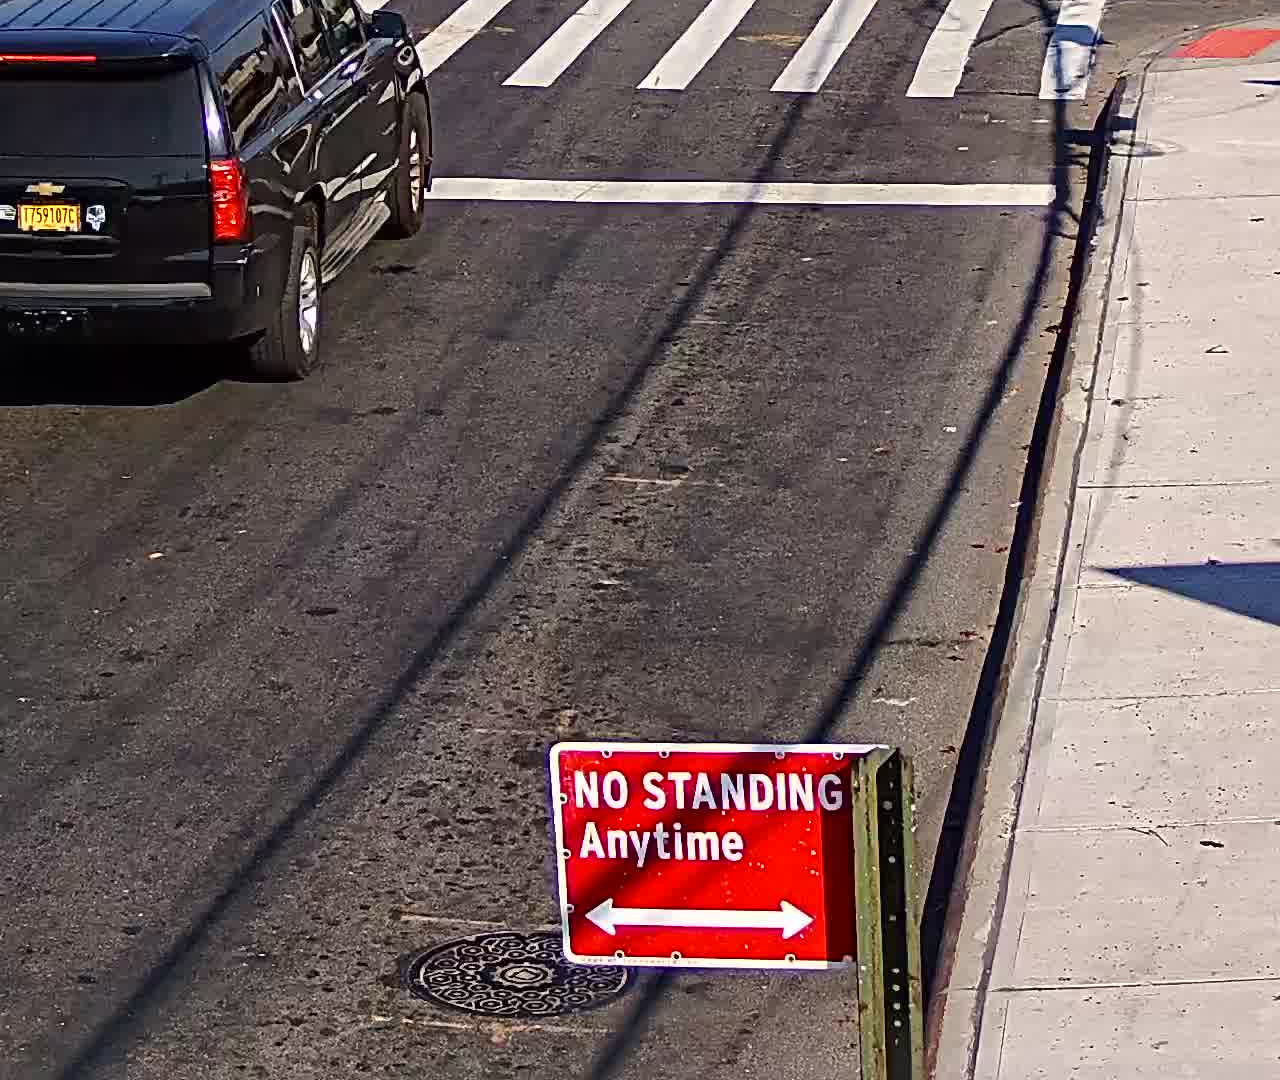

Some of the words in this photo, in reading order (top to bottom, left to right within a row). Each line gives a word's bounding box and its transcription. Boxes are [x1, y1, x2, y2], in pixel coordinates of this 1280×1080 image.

[24, 207, 75, 224] T759107C
[574, 771, 628, 809] NO
[642, 771, 844, 811] STANDING
[579, 822, 745, 868] Anytime
